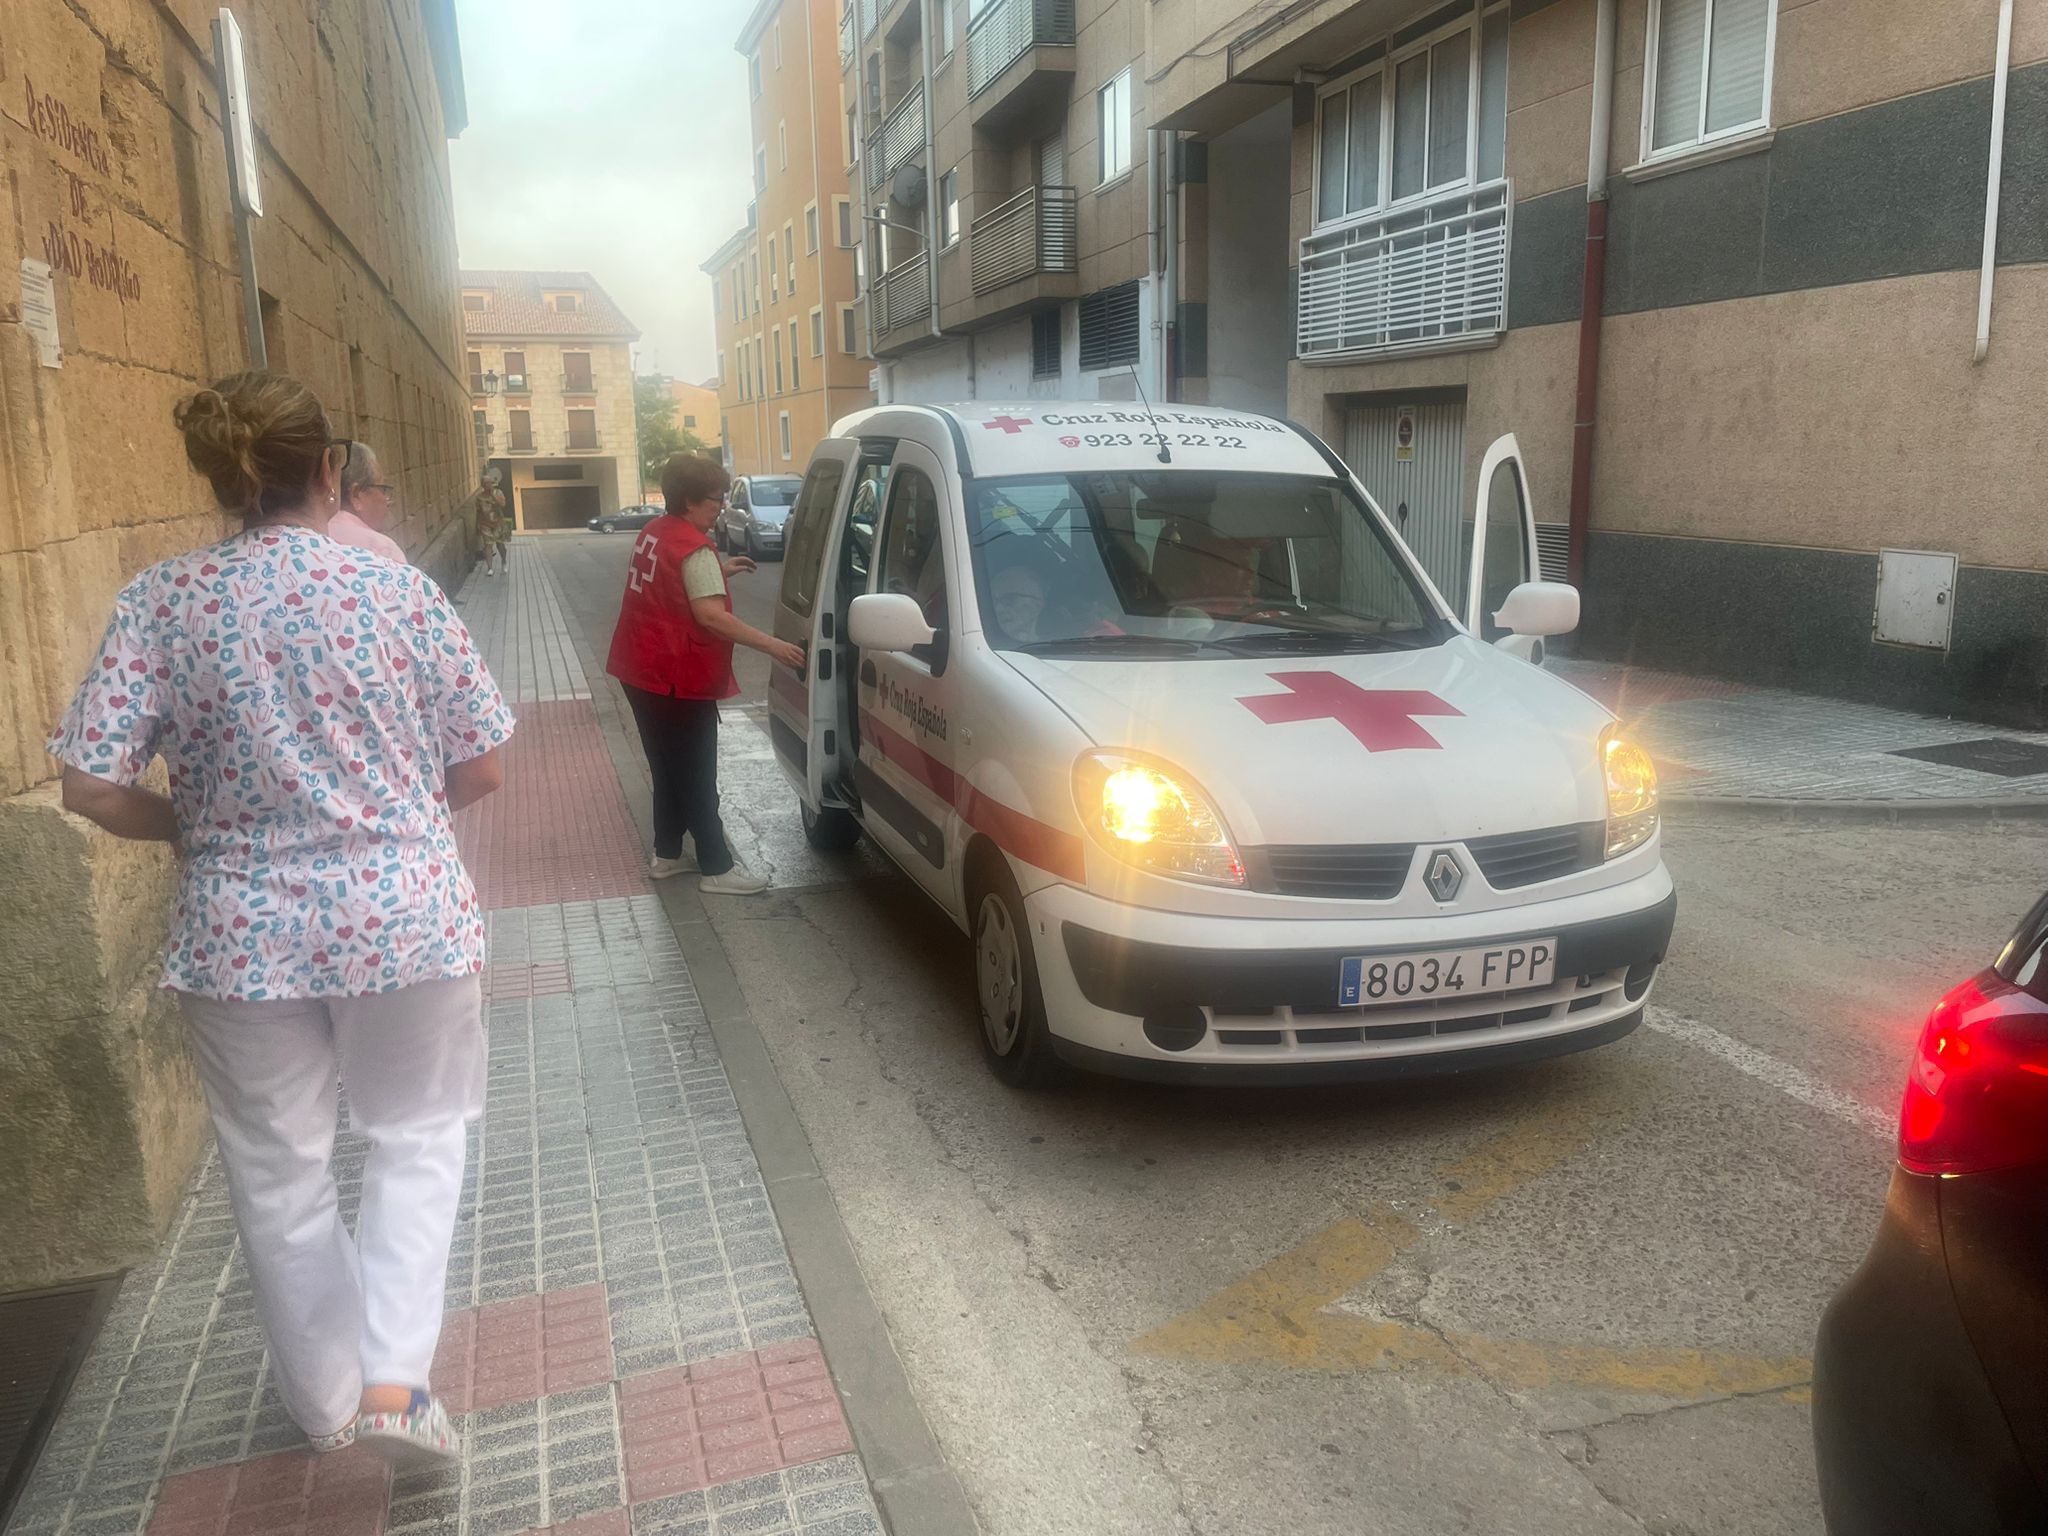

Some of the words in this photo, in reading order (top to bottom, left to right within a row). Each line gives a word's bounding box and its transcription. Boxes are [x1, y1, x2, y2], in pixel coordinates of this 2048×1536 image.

[1041, 414, 1108, 426] Cruz
[1107, 411, 1171, 427] Roja
[1170, 413, 1286, 434] Española
[1084, 433, 1133, 448] 923
[1139, 433, 1173, 446] 22
[1177, 433, 1211, 447] 22
[1214, 435, 1248, 449] 22
[889, 679, 904, 714] Cruz
[903, 687, 918, 729] Roja
[1366, 955, 1465, 999] 8034
[1481, 945, 1549, 988] FPP
[1346, 986, 1355, 998] E
